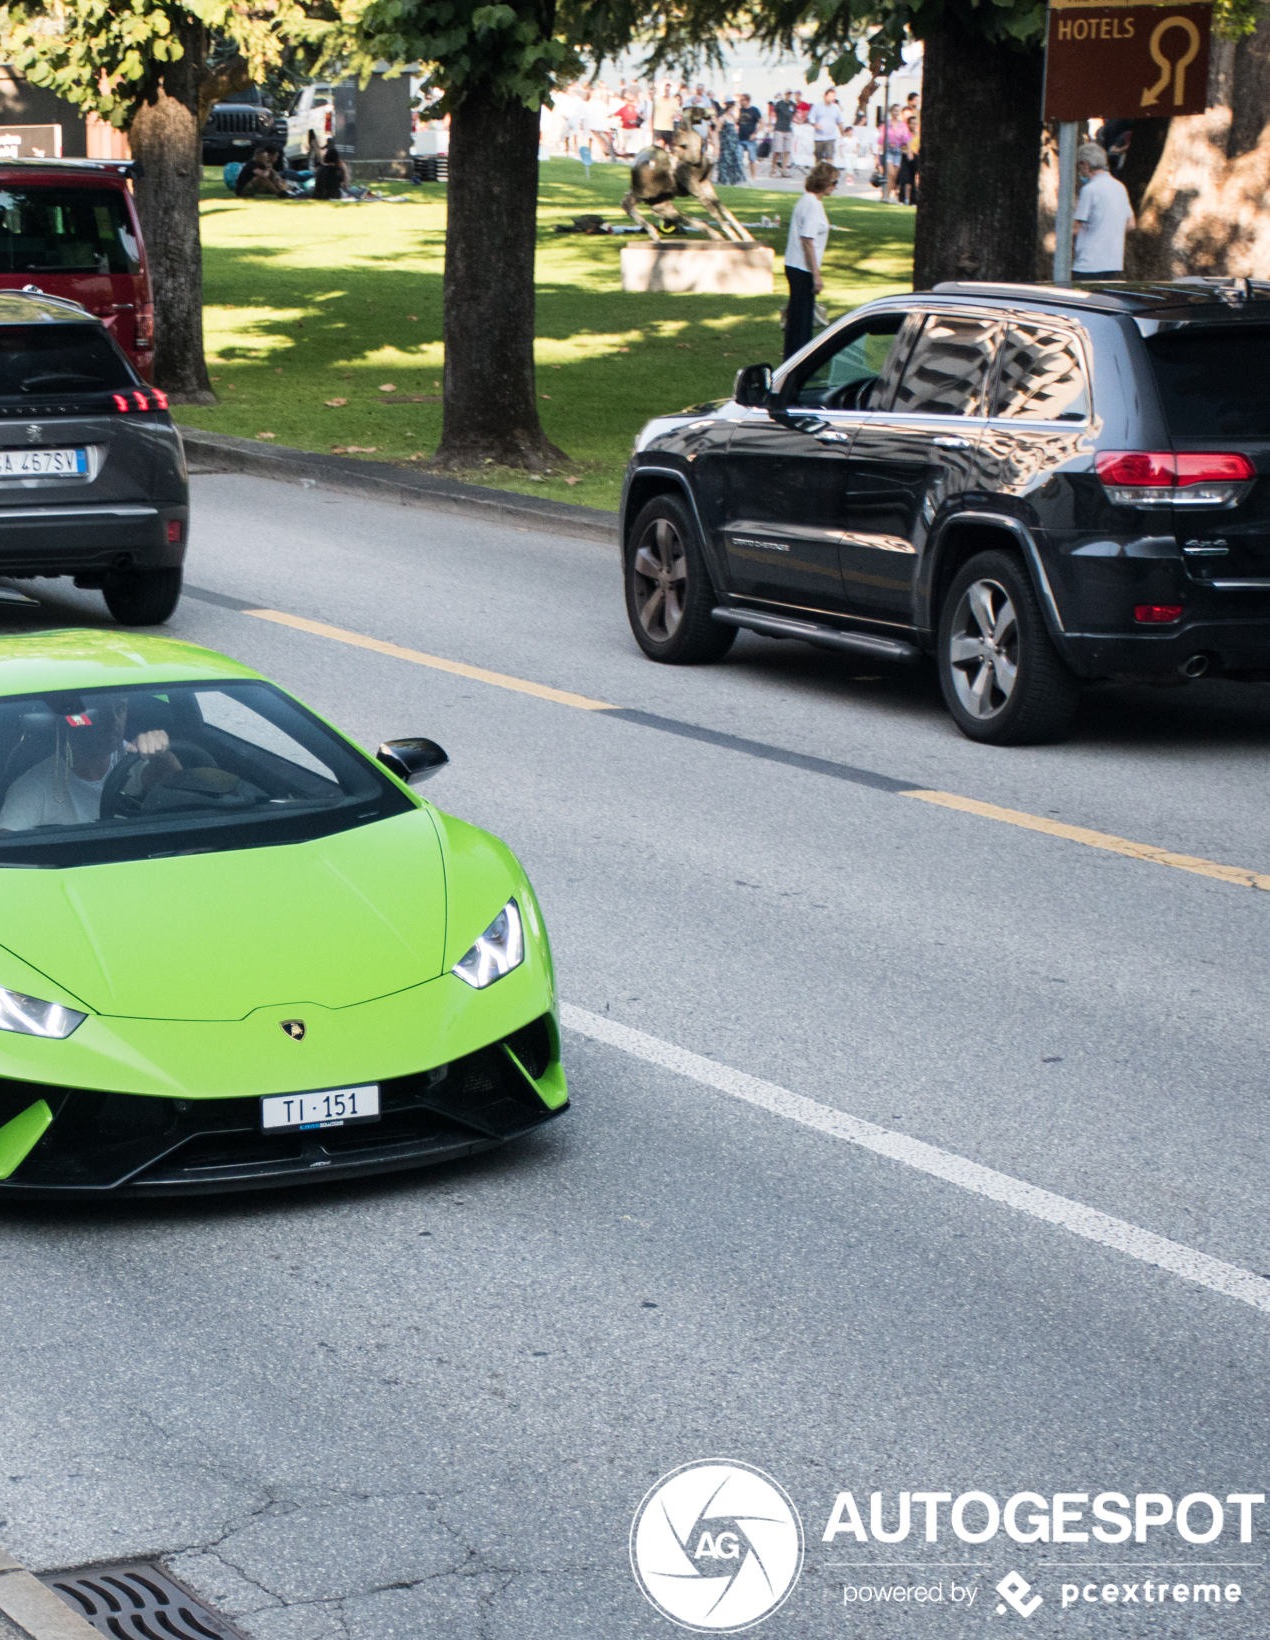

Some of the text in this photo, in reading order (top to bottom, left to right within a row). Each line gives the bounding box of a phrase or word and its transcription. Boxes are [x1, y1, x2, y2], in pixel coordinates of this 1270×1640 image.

[1057, 17, 1136, 41] HOTELS
[20, 452, 75, 473] 467SV
[322, 1092, 359, 1118] 151
